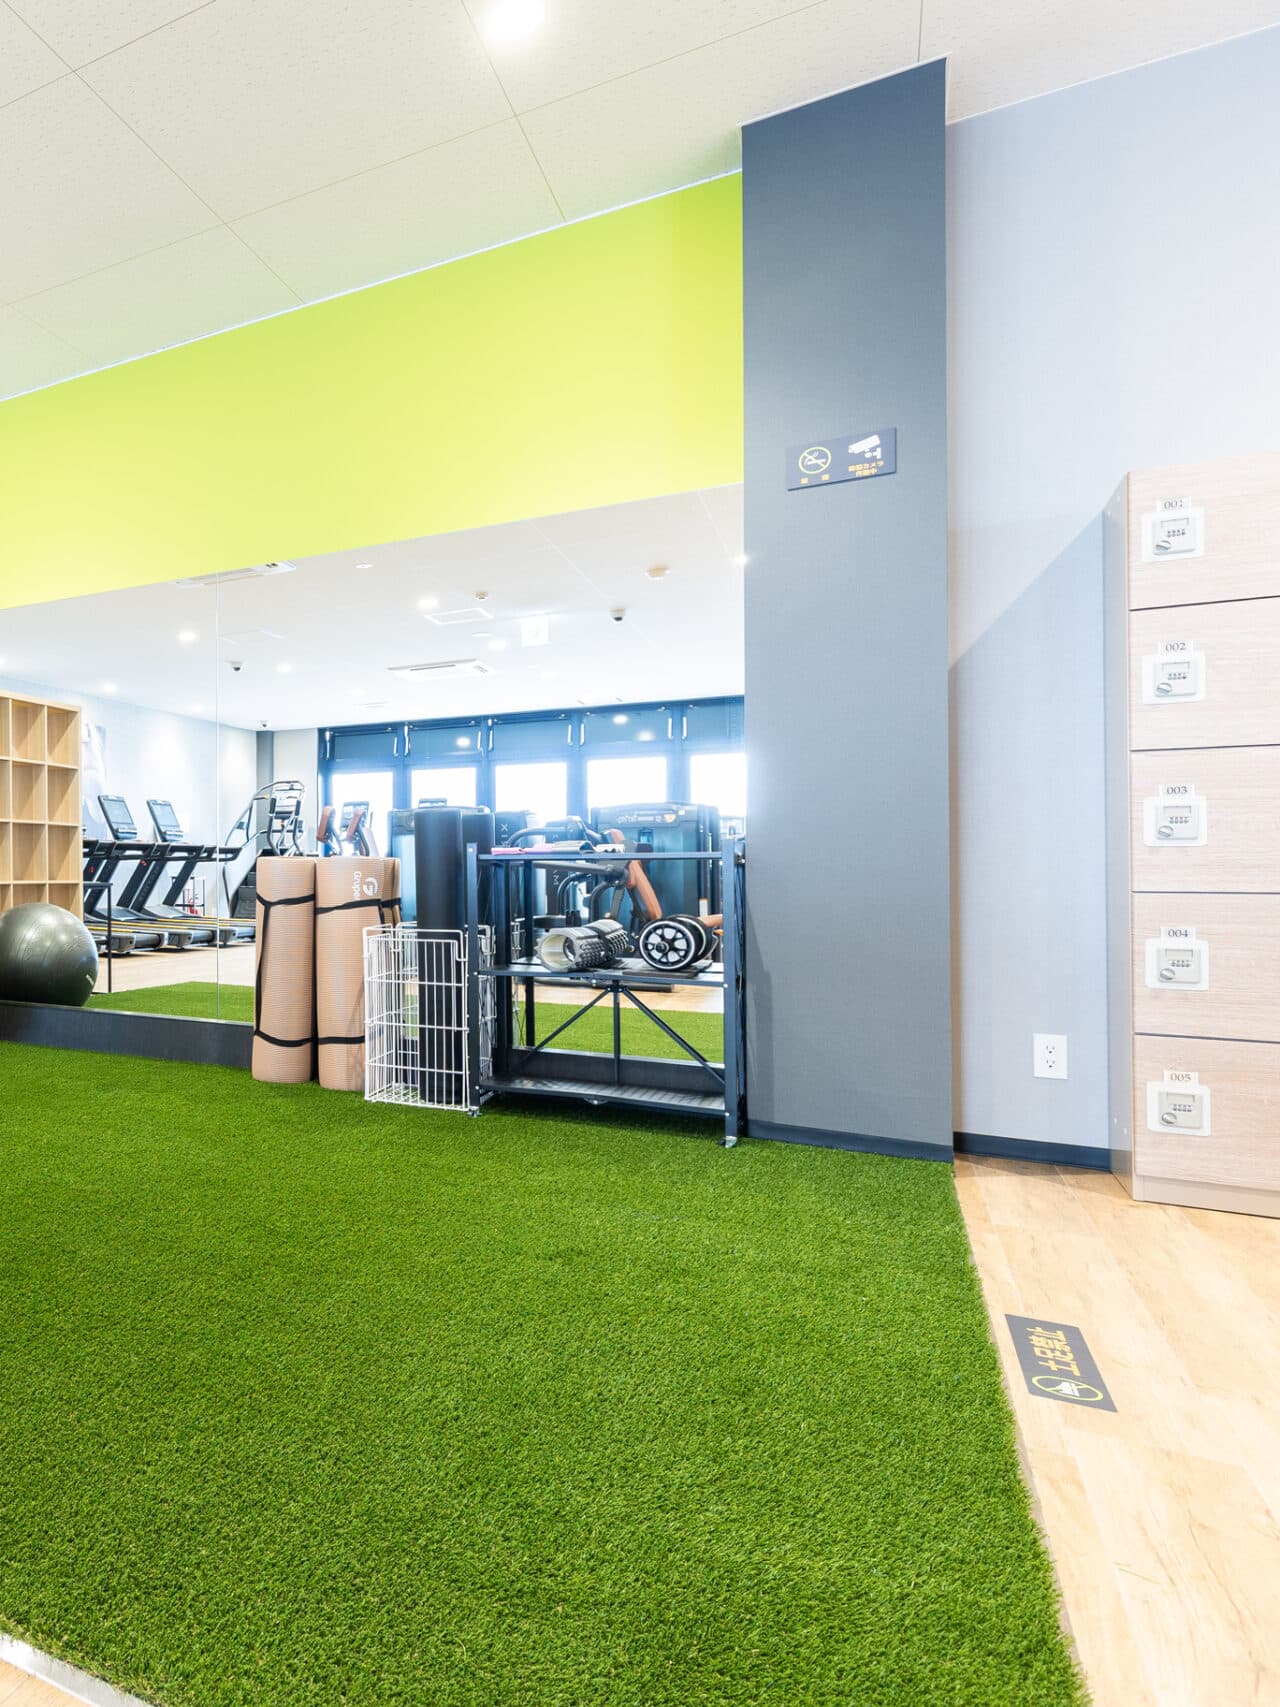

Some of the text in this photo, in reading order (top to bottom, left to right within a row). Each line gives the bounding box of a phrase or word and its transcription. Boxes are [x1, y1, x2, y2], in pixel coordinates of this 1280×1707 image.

[1165, 642, 1187, 653] 002
[1166, 785, 1188, 796] 003
[1167, 929, 1189, 939] 004
[1169, 1072, 1192, 1082] 005
[1026, 1326, 1081, 1377] 土足禁止
